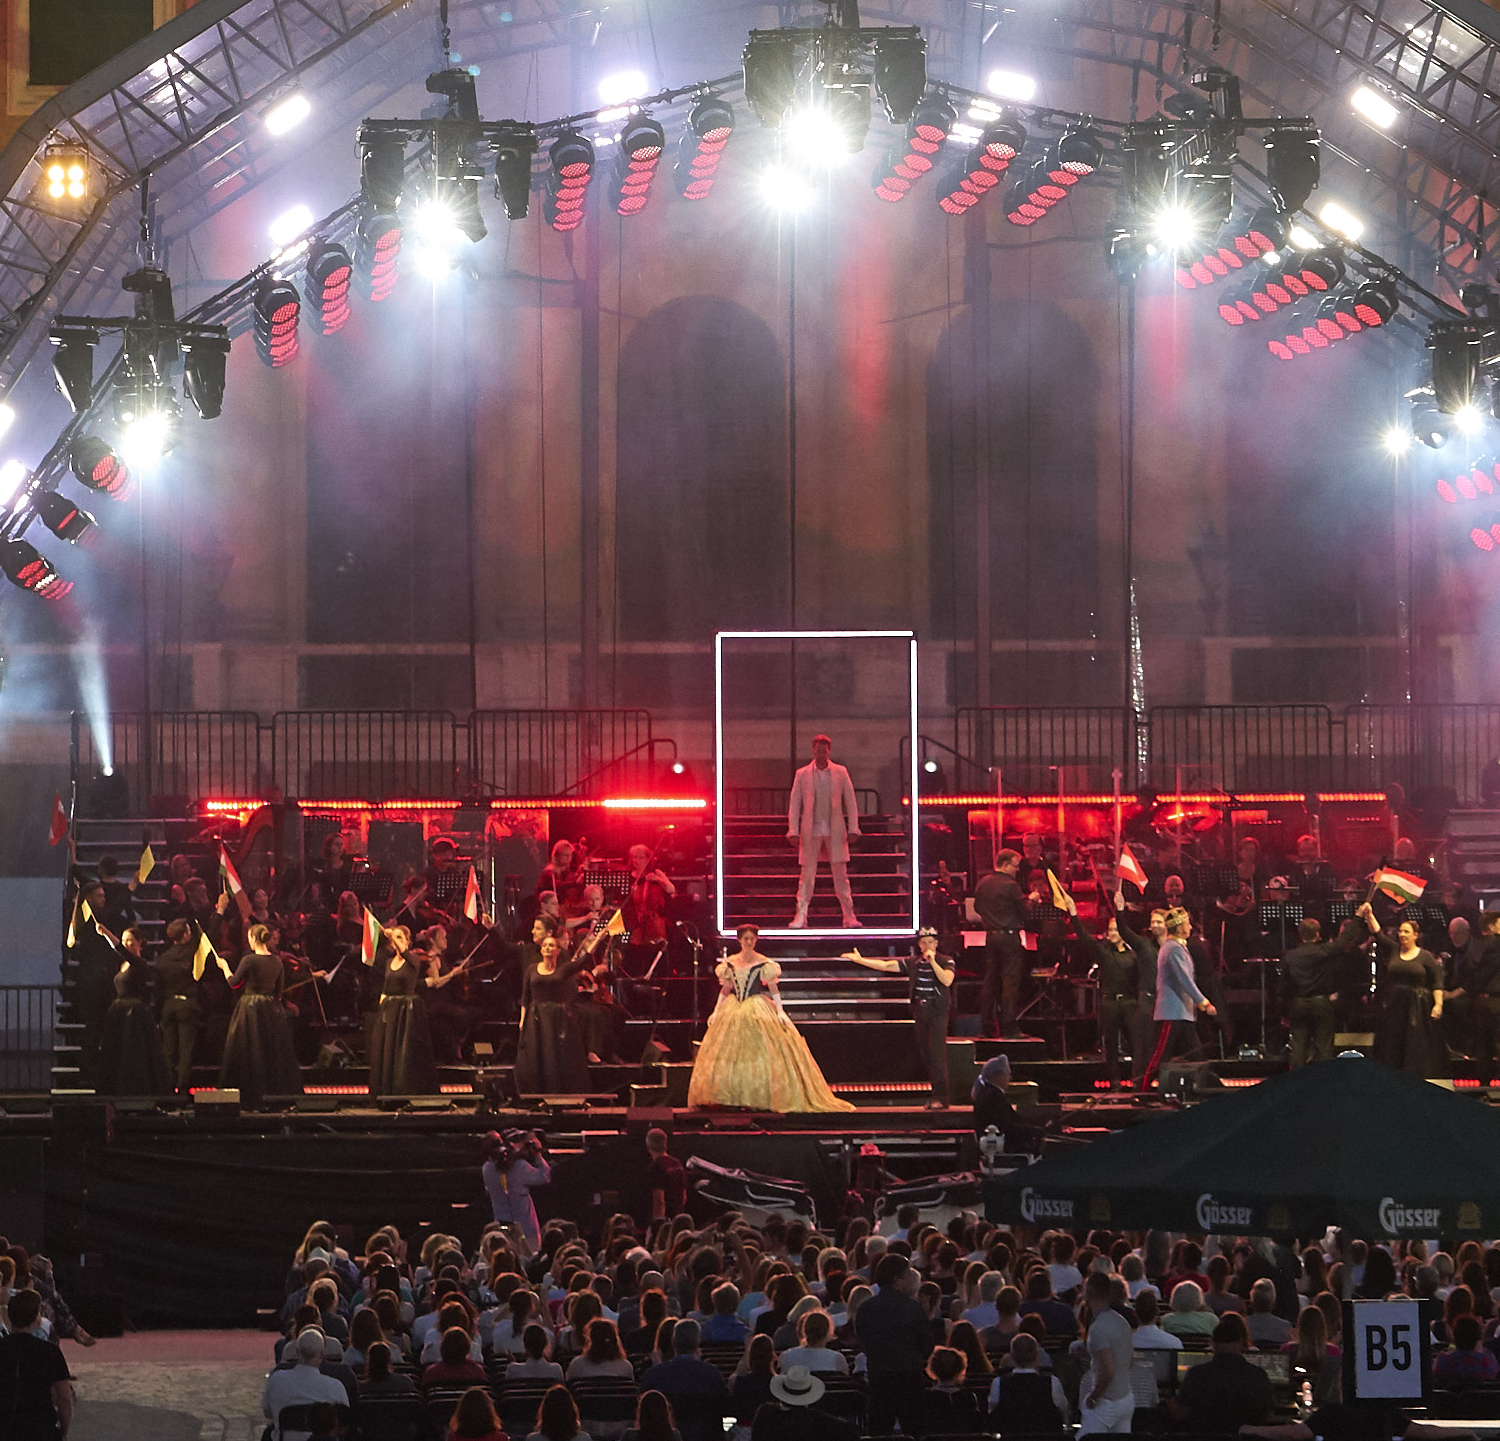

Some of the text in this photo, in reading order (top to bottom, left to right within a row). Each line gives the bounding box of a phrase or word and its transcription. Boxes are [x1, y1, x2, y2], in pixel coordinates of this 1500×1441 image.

[1196, 1192, 1252, 1231] Gösser
[1378, 1196, 1441, 1234] Gösser
[1365, 1324, 1411, 1371] B5
